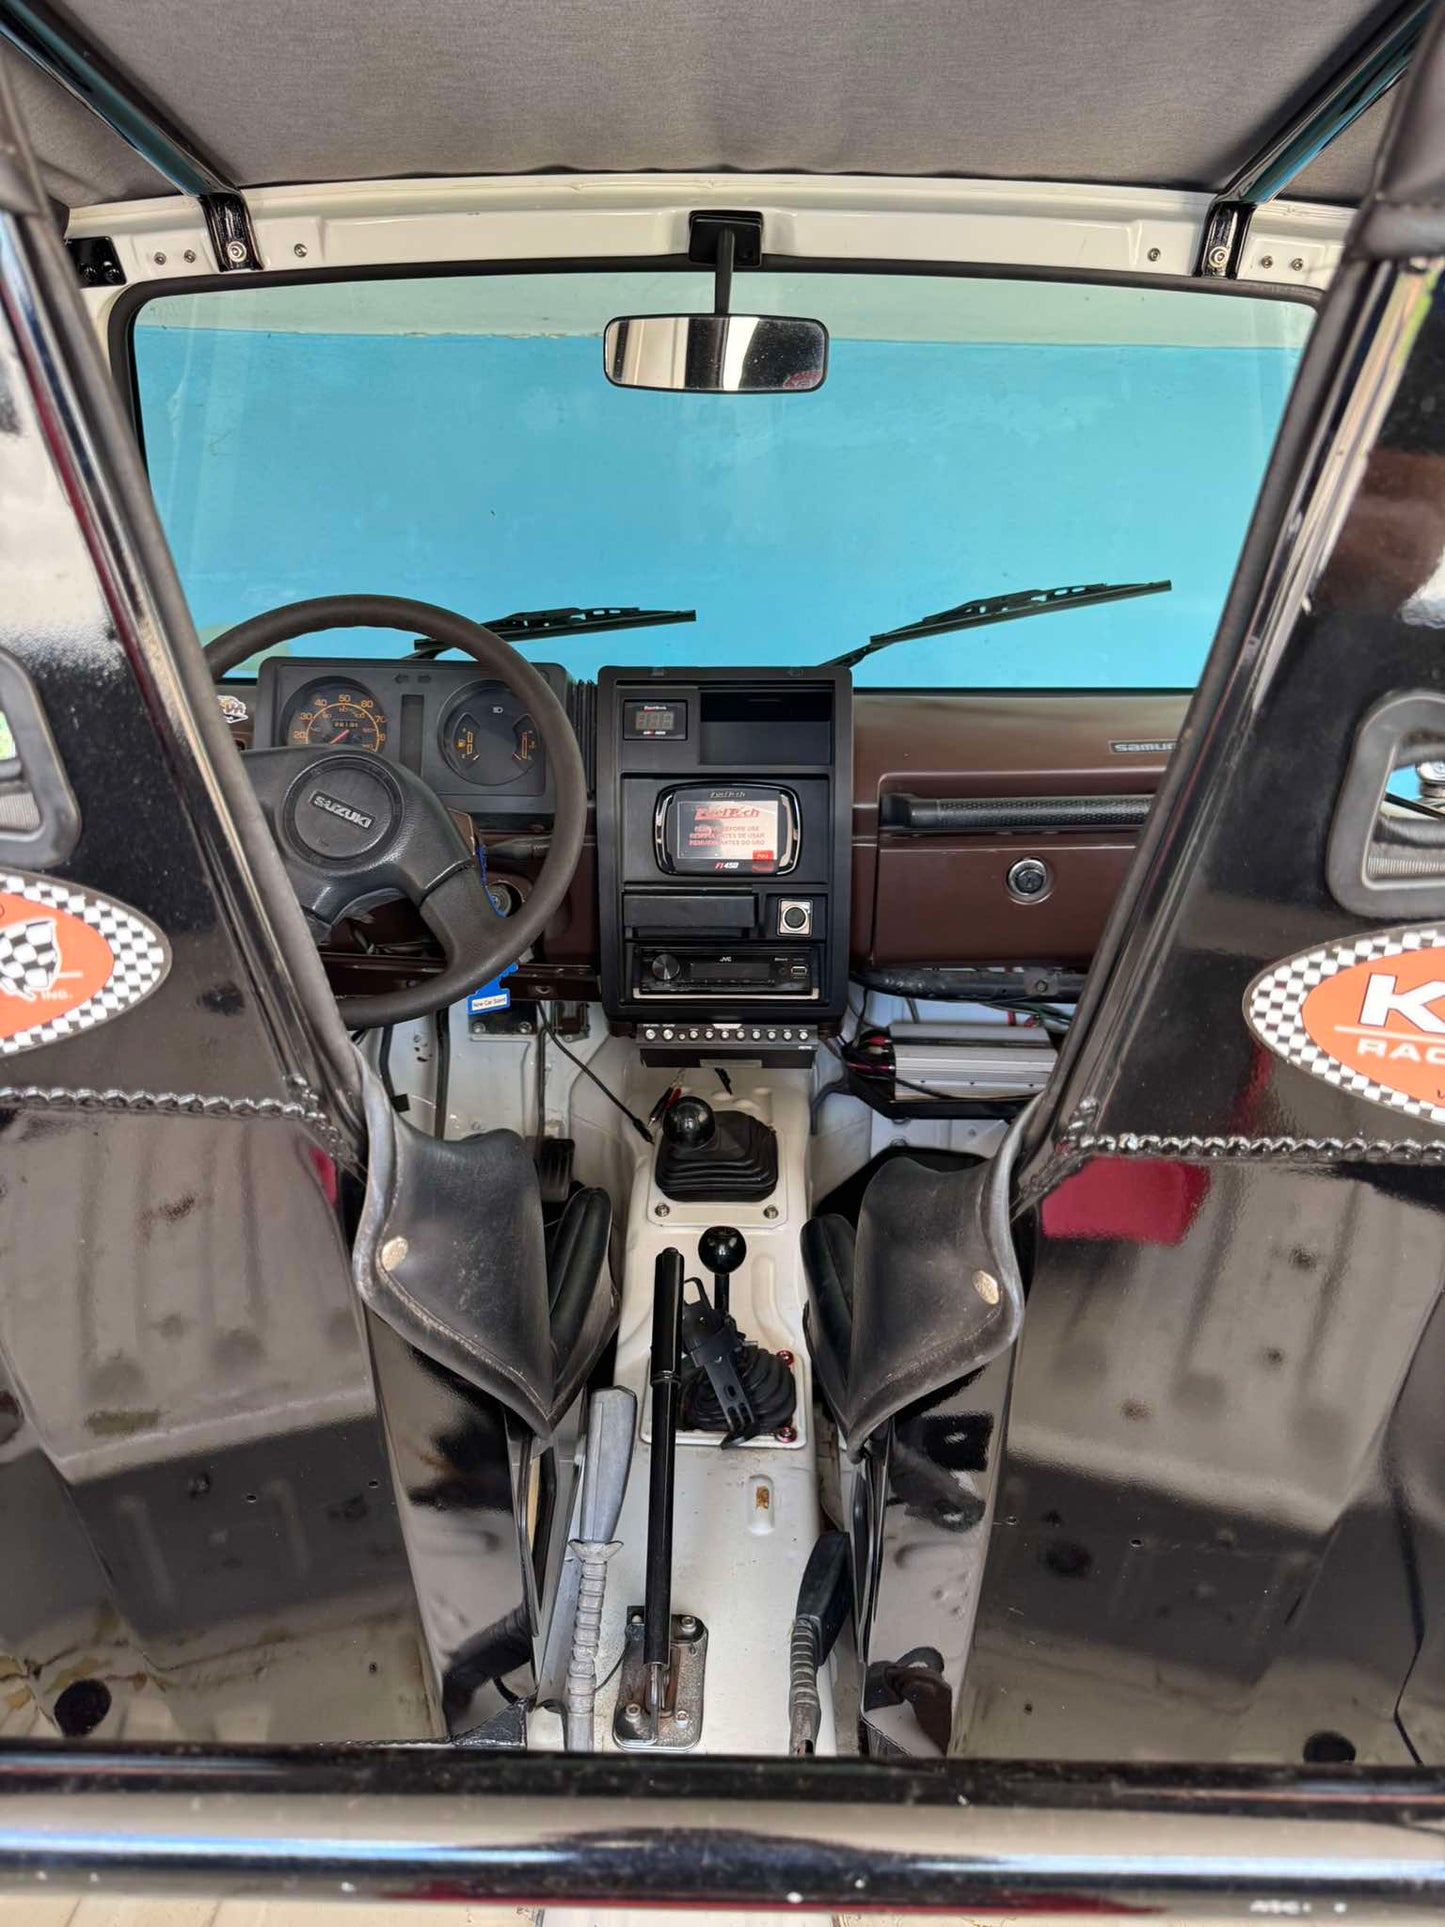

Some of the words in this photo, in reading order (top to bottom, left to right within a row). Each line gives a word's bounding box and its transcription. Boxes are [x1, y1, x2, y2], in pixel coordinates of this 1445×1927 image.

[314, 795, 372, 828] SUZUKI
[1359, 972, 1445, 1035] K
[1357, 1038, 1445, 1064] RAC
